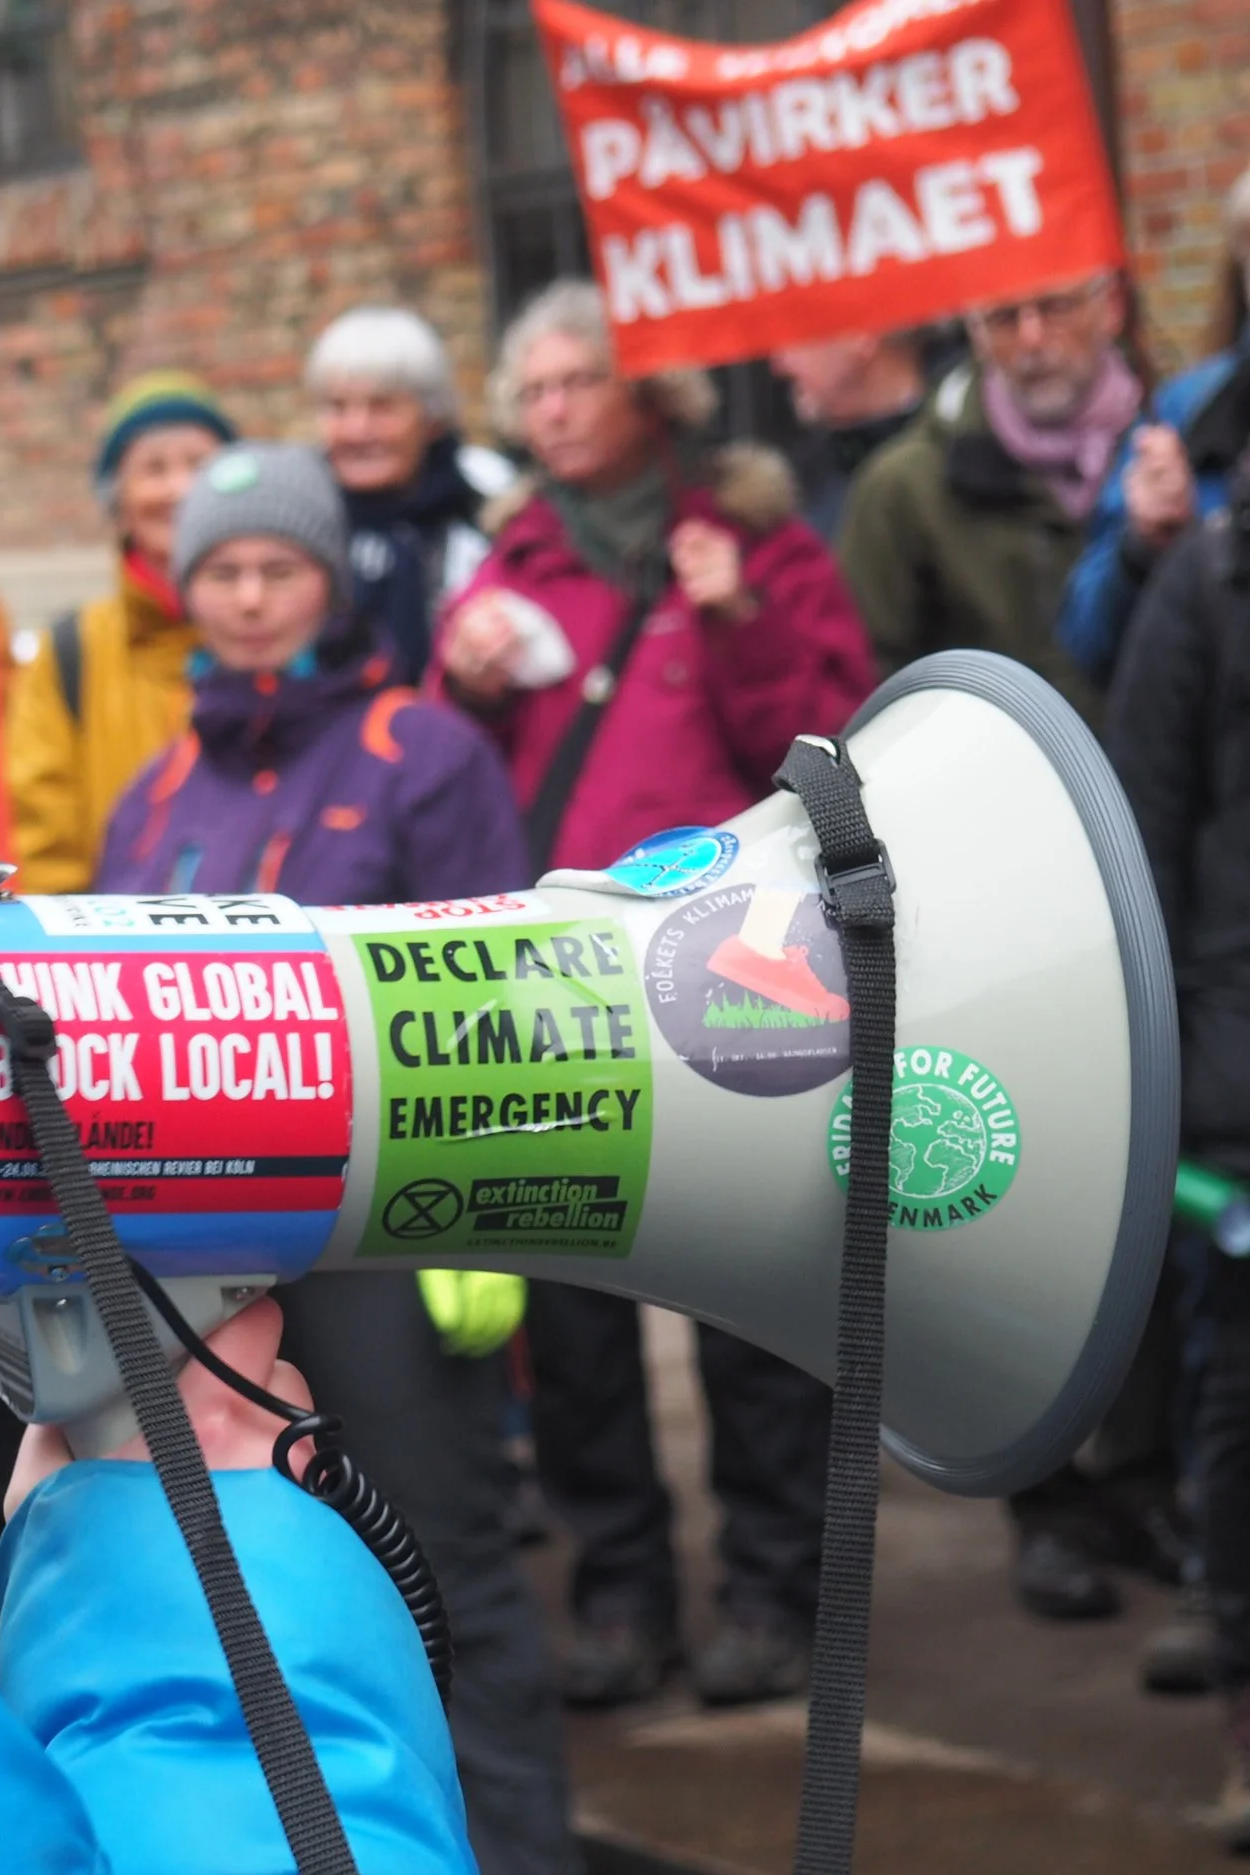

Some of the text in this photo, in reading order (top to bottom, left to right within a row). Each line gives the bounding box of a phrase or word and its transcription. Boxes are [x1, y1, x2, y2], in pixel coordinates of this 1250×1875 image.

[581, 37, 1020, 199] PÅVIRKER
[602, 146, 1043, 323] KLIMAET
[366, 932, 623, 982] DECLARE
[651, 928, 685, 1004] FOLKETS
[682, 889, 755, 925] KLIMAM
[143, 961, 338, 1022] GLOBAL
[389, 1004, 636, 1068] CLIMATE
[159, 1032, 335, 1102] LOCAL!
[389, 1089, 641, 1140] EMERGENCY
[893, 1049, 953, 1079] FOR
[958, 1063, 1017, 1166] FUTURE
[163, 1160, 202, 1176] REVIER
[204, 1160, 223, 1175] BEI
[225, 1158, 255, 1175] KÖLN
[476, 1178, 598, 1204] extinction
[506, 1202, 619, 1229] rebellion
[887, 1184, 998, 1228] ENMARK
